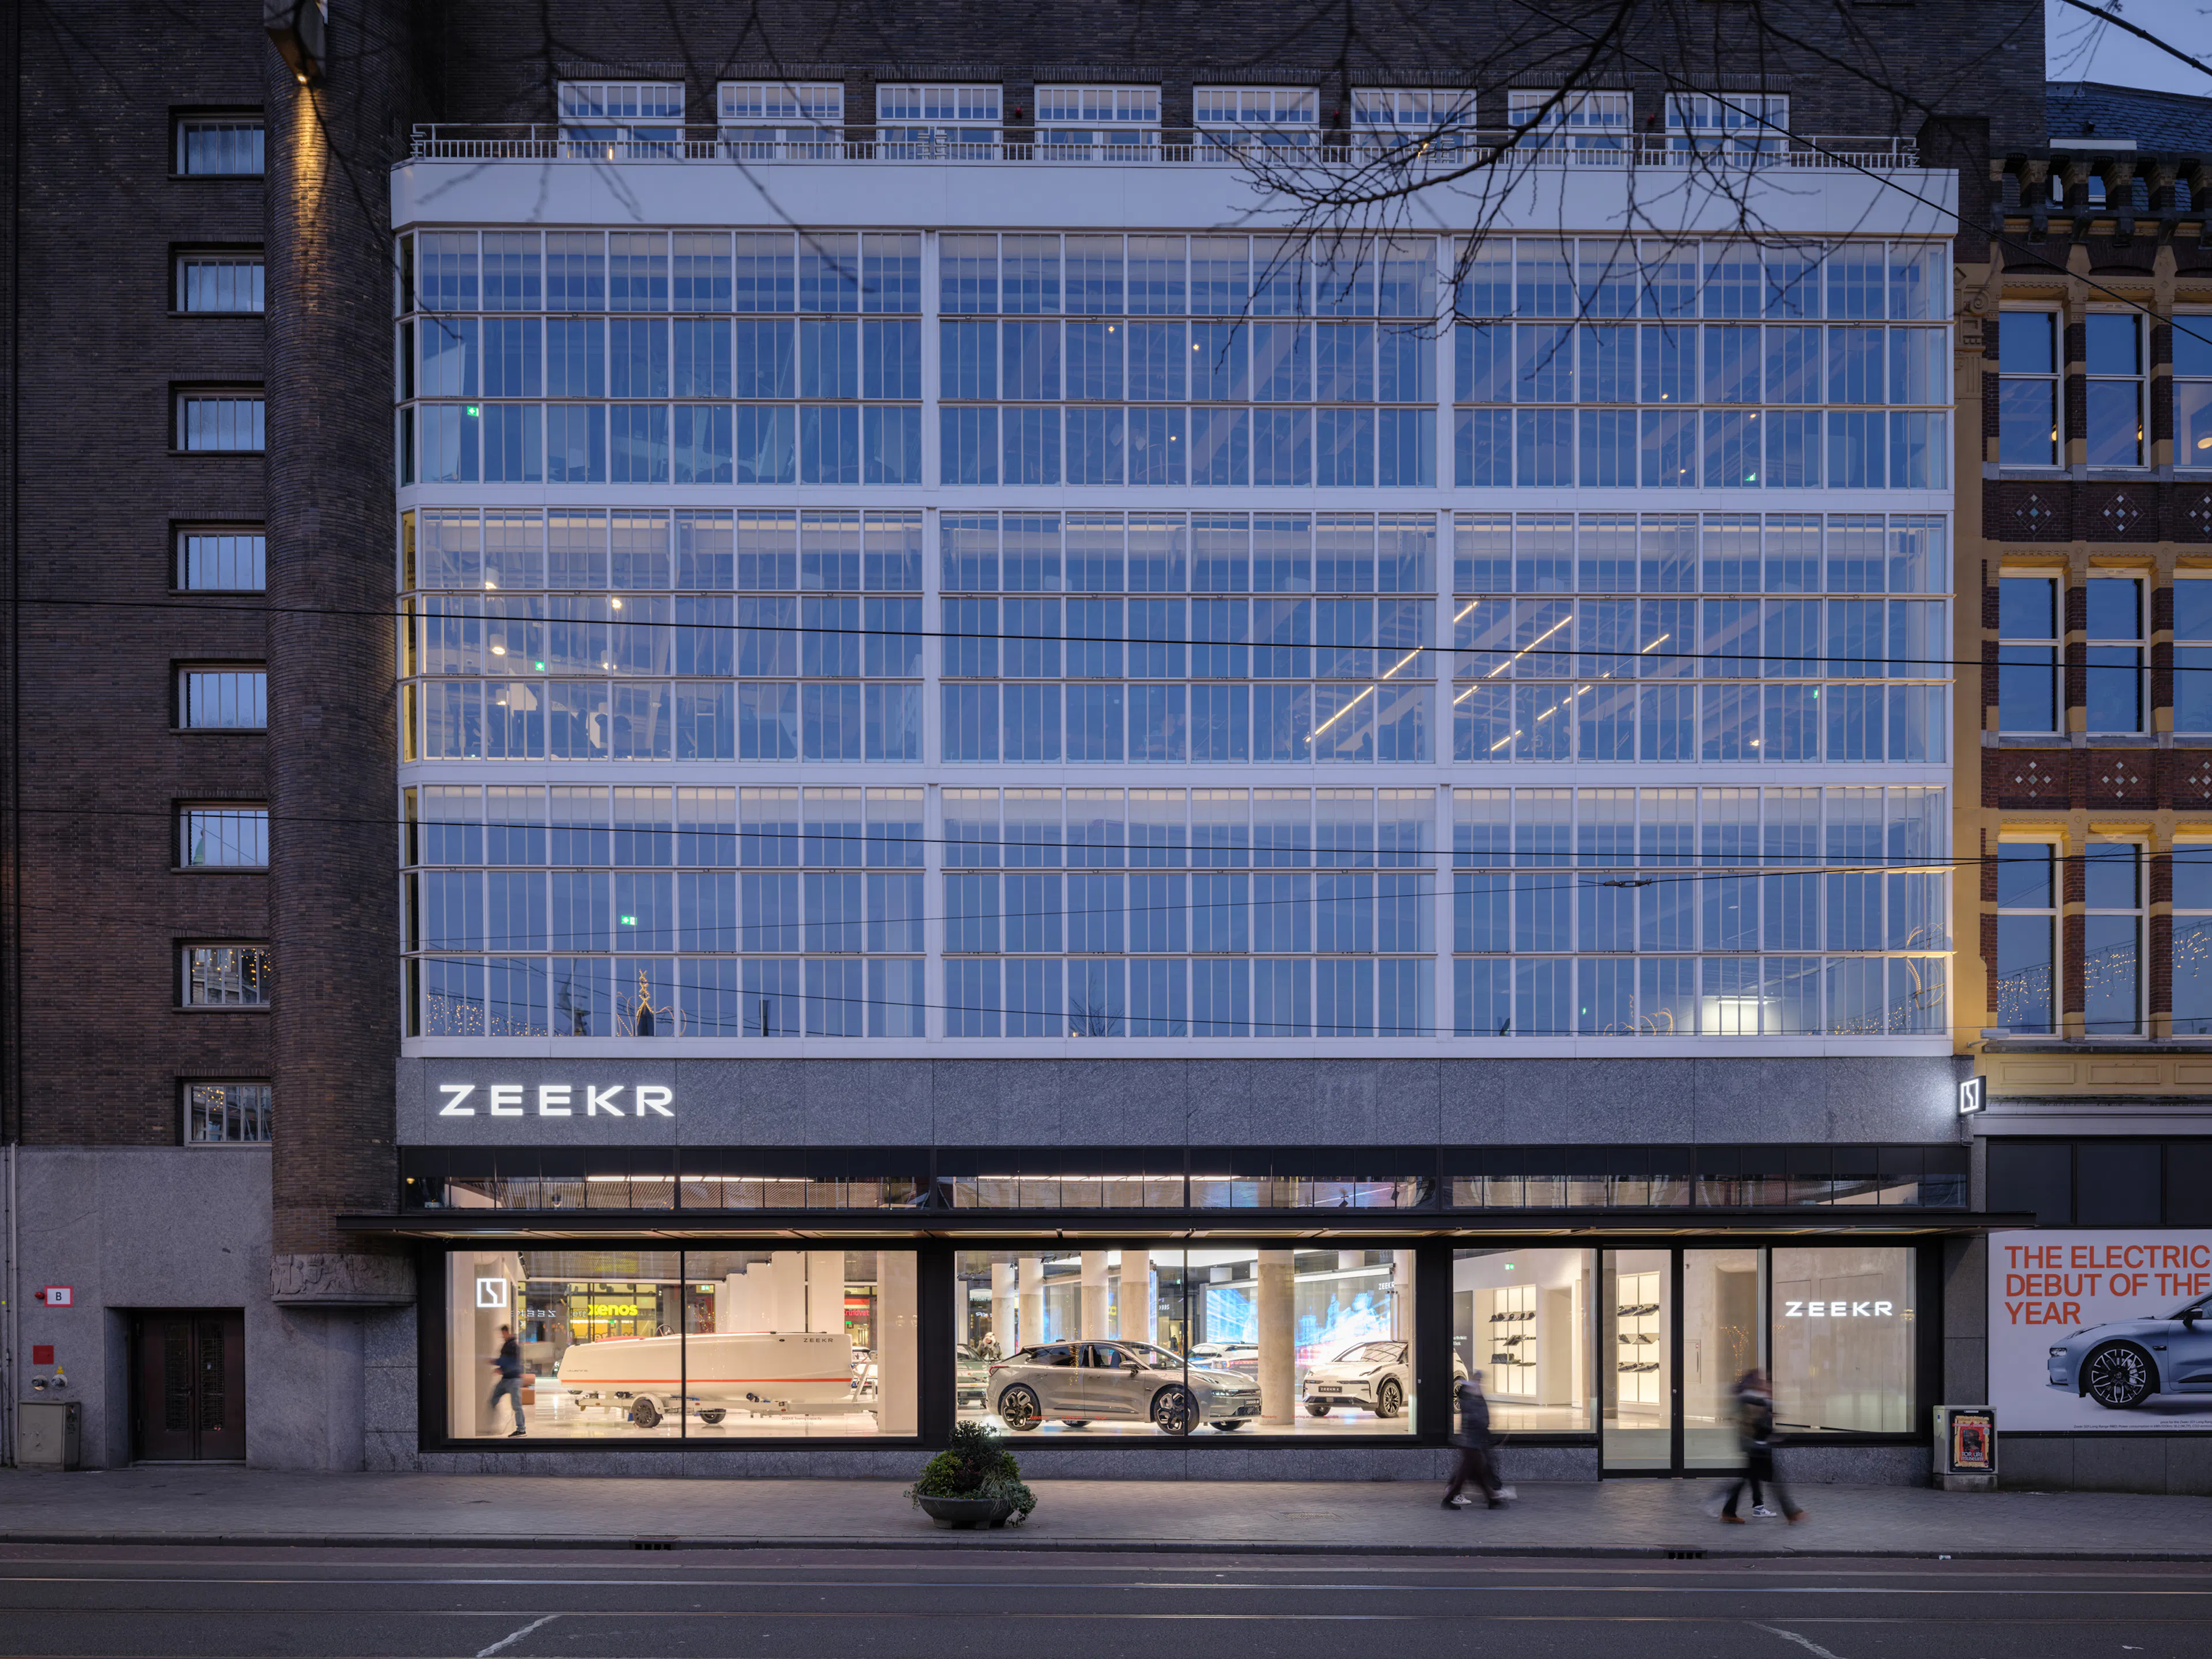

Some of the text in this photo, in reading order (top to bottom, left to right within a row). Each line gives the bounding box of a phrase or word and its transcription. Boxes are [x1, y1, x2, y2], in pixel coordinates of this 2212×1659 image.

[439, 1085, 675, 1116] ZEEKR
[2005, 1245, 2210, 1268] THE ELECTRIC
[2006, 1273, 2210, 1296] DEBUT OF THE
[55, 1292, 62, 1301] B
[588, 1304, 638, 1316] xenos
[1785, 1301, 1892, 1316] ZEEKR
[2005, 1302, 2081, 1324] YEAR
